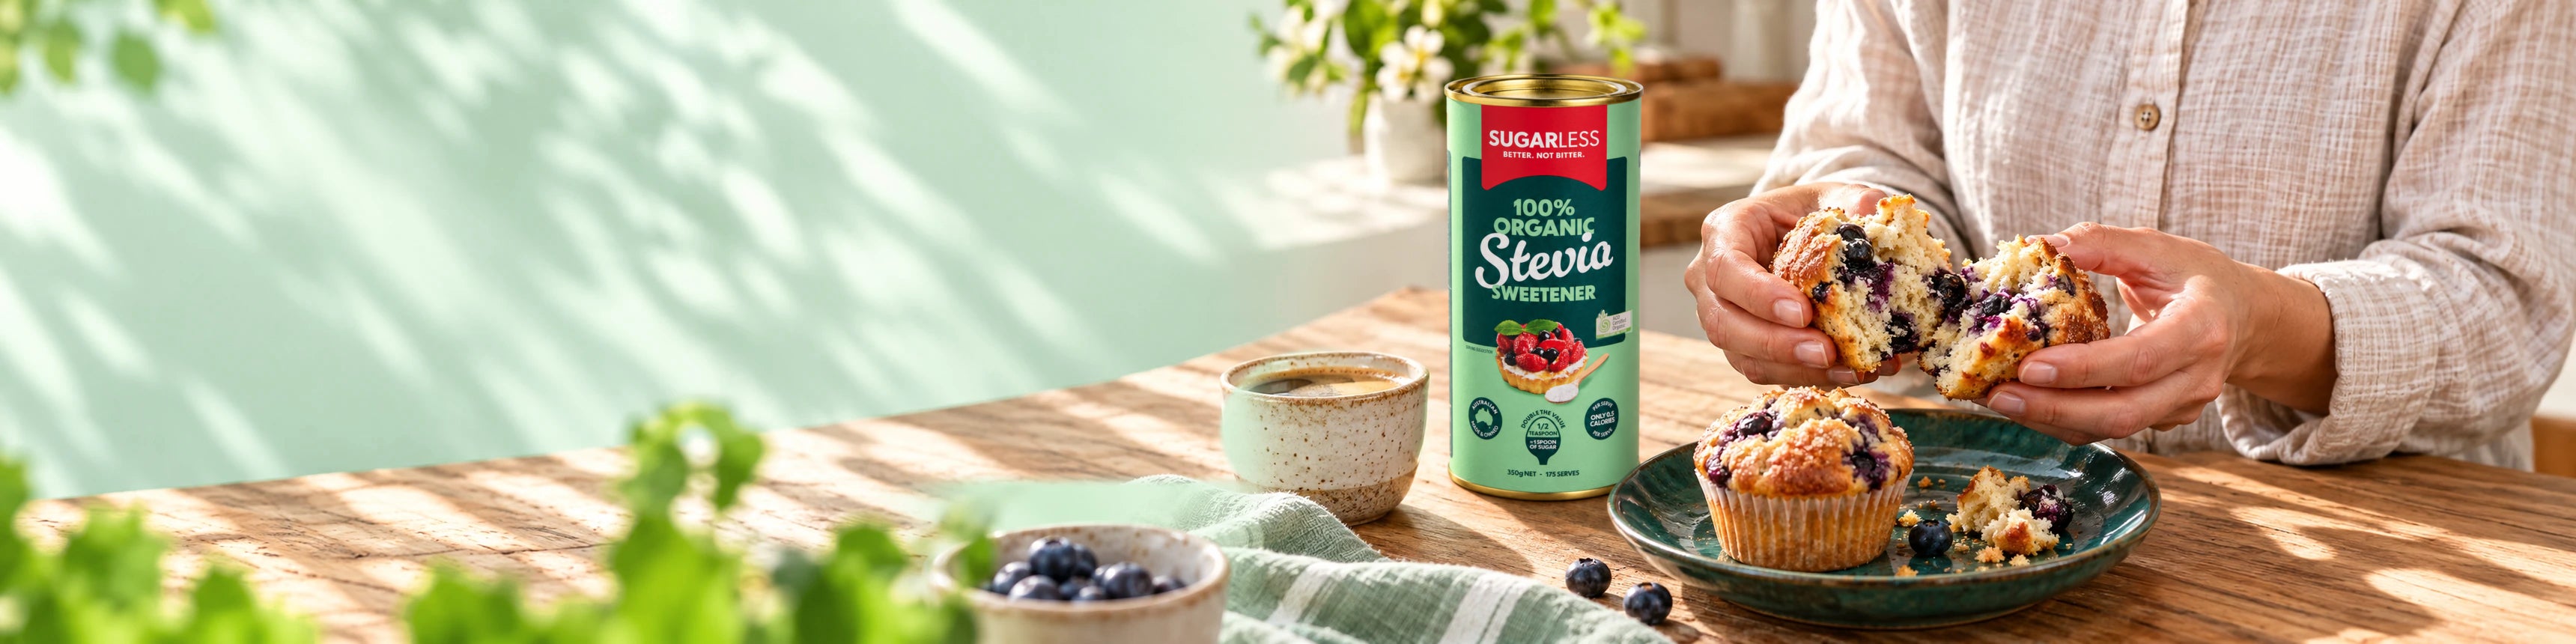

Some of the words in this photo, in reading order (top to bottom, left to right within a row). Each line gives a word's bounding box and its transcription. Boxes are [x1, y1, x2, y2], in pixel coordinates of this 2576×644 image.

[1489, 130, 1600, 148] SUGARLESS
[1503, 151, 1534, 159] BETTER.
[1513, 198, 1576, 217] 100%
[1493, 217, 1595, 237] ORGANIC
[1474, 231, 1614, 289] Stevia
[1491, 285, 1597, 303] SWEETENER
[1471, 400, 1498, 415] AUSTRALIAN
[1592, 403, 1601, 411] PER
[1521, 410, 1540, 428] DOUBLE
[1552, 412, 1567, 429] VALUE
[1590, 416, 1615, 427] CALORIES
[1591, 413, 1606, 421] ONLY
[1471, 420, 1480, 434] MADE
[1484, 425, 1498, 437] OWNED
[1600, 427, 1613, 437] SERVE
[1507, 469, 1524, 478] 350g
